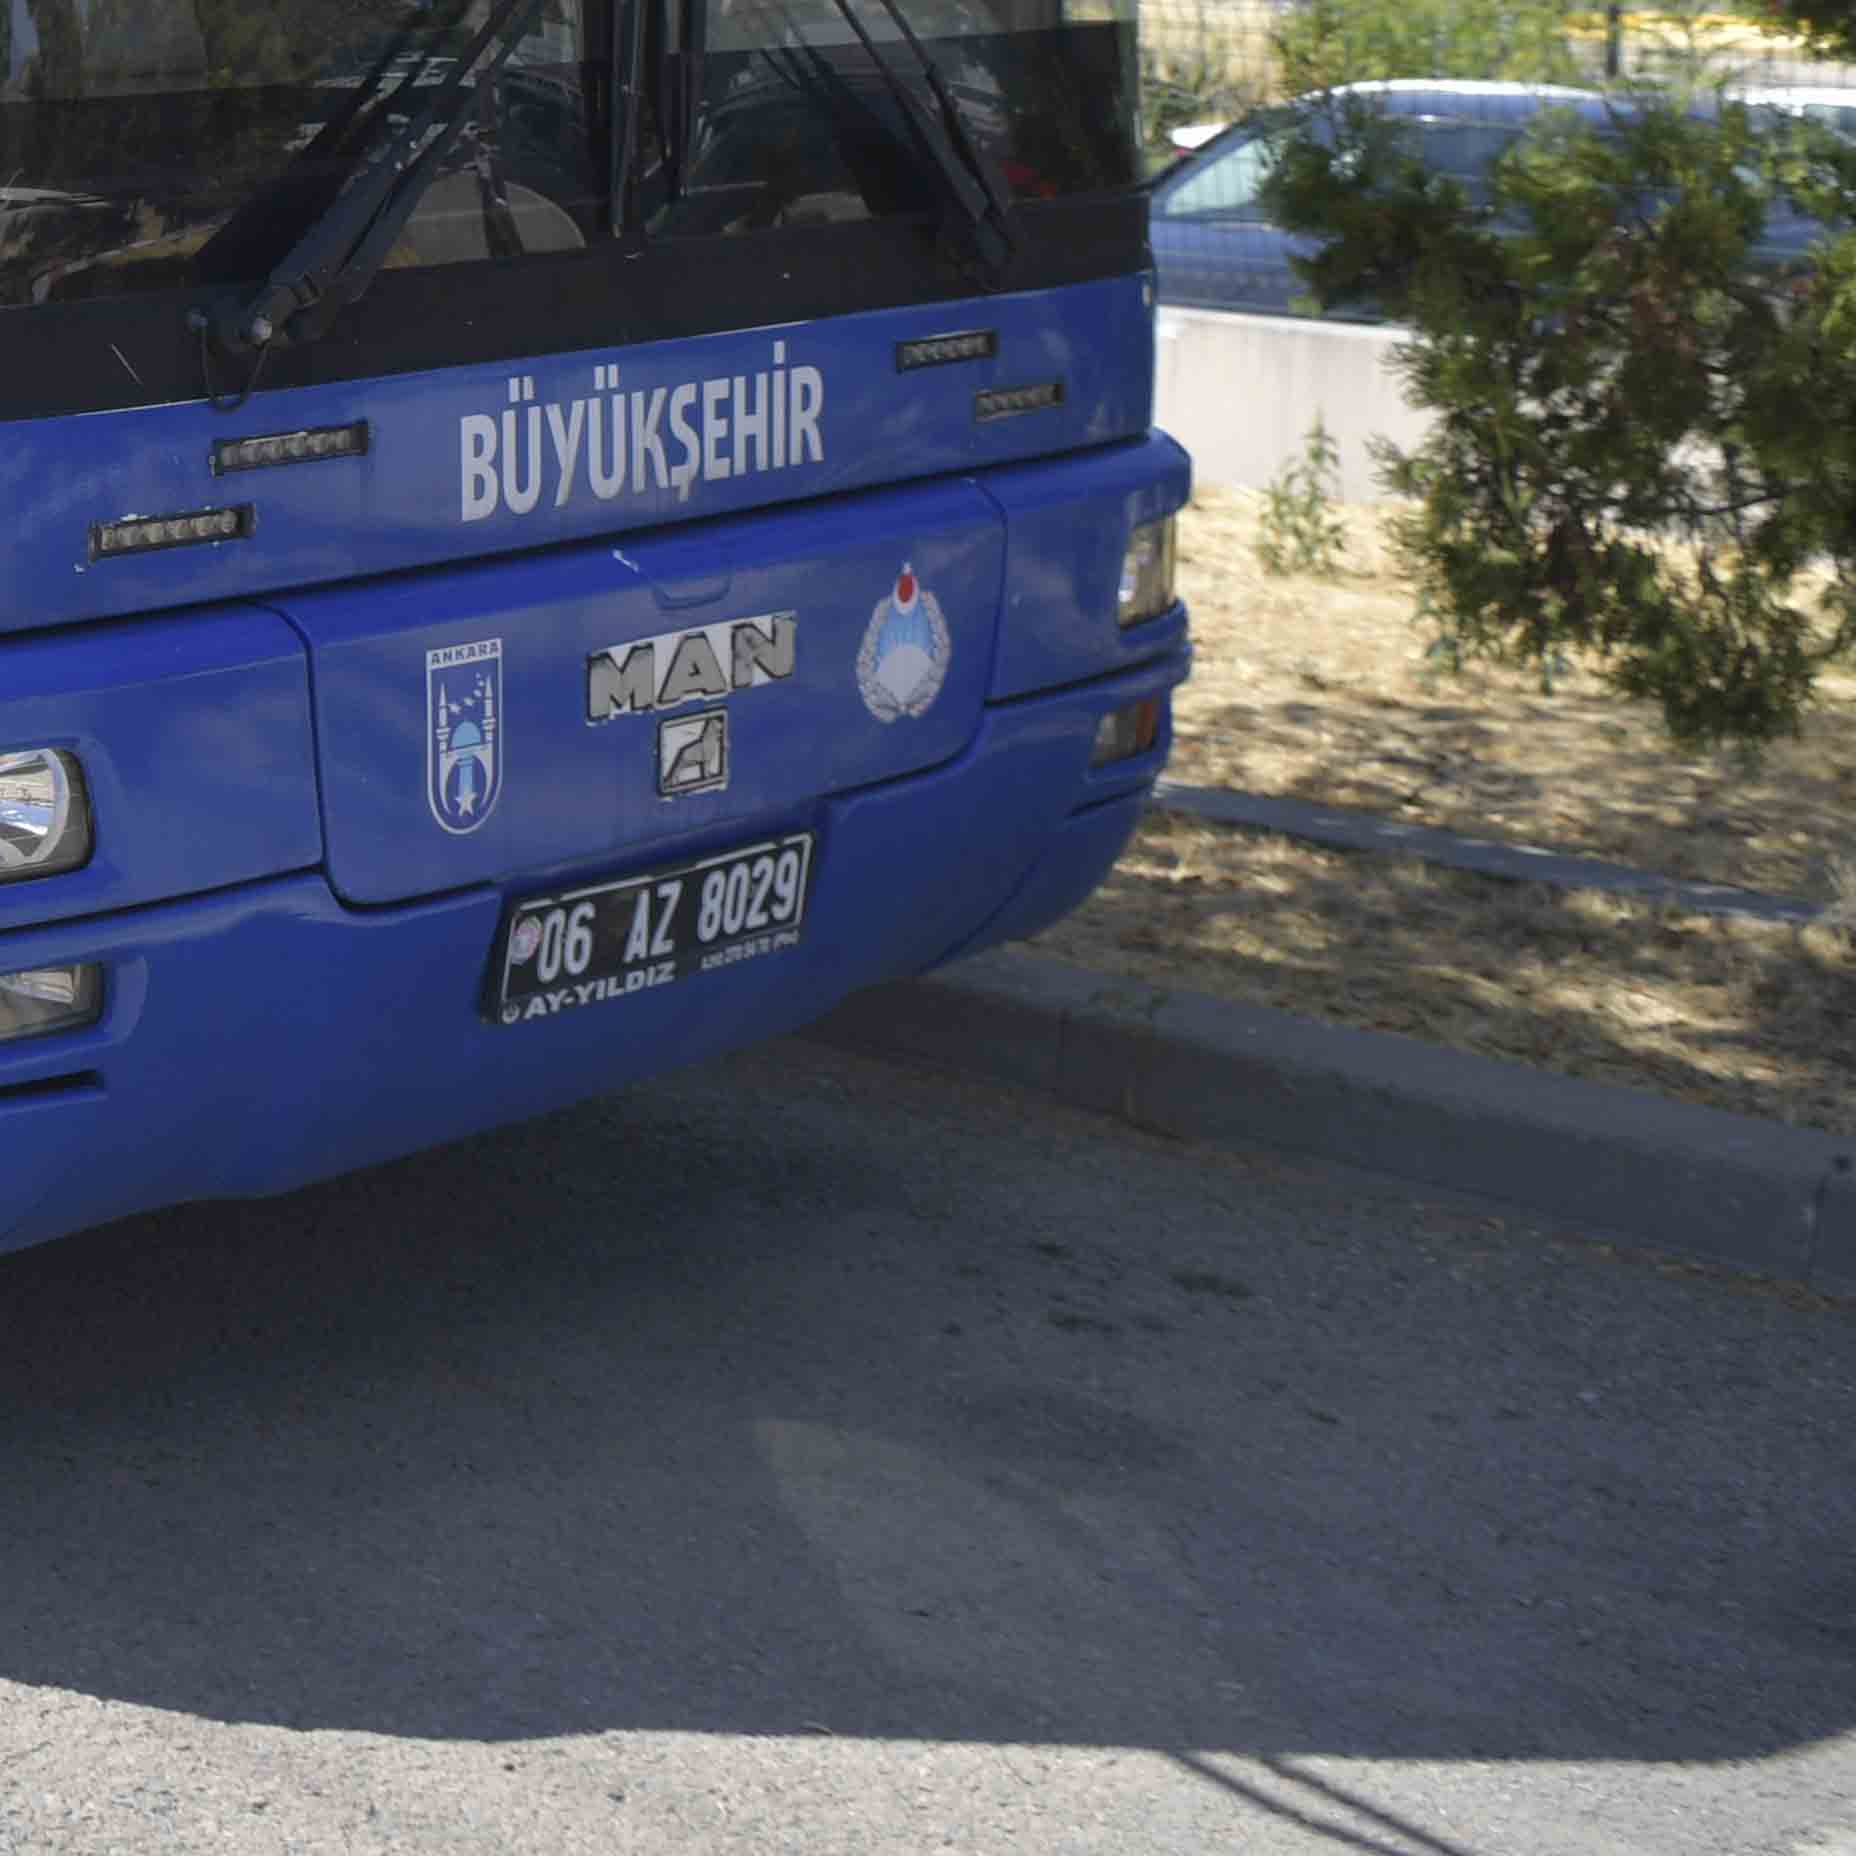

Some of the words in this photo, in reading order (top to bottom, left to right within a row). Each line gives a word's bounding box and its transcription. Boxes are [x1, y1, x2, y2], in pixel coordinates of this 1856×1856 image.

[460, 340, 825, 522] BÜYÜKŞEHİR
[429, 640, 501, 667] ANKARA
[585, 615, 798, 724] MAN
[536, 901, 597, 984] 06
[622, 879, 684, 964] AZ
[696, 848, 802, 944] 8029
[523, 960, 678, 1021] AY-YILDIZ
